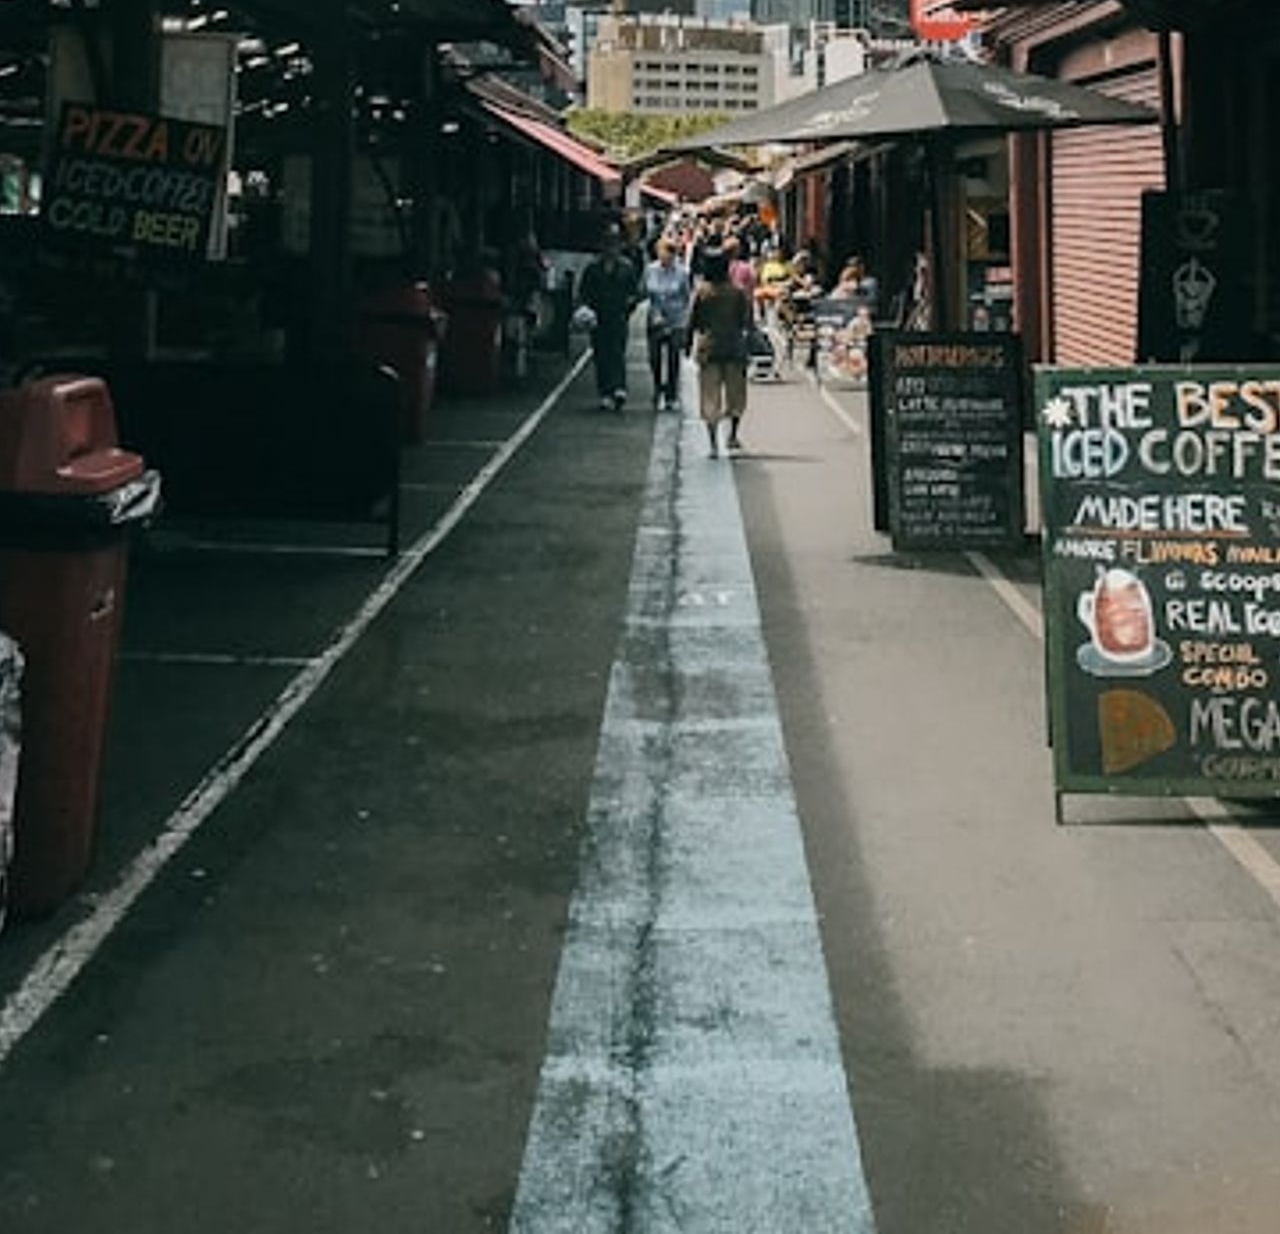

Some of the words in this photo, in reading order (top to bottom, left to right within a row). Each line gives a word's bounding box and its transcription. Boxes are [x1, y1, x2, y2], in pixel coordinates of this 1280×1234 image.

[63, 107, 169, 164] PIZZA
[54, 157, 122, 197] ICED
[48, 197, 126, 236] COLD
[131, 208, 201, 251] BEER
[1061, 383, 1153, 429] THE
[1051, 429, 1129, 479] ICED
[1165, 600, 1240, 635] REAL
